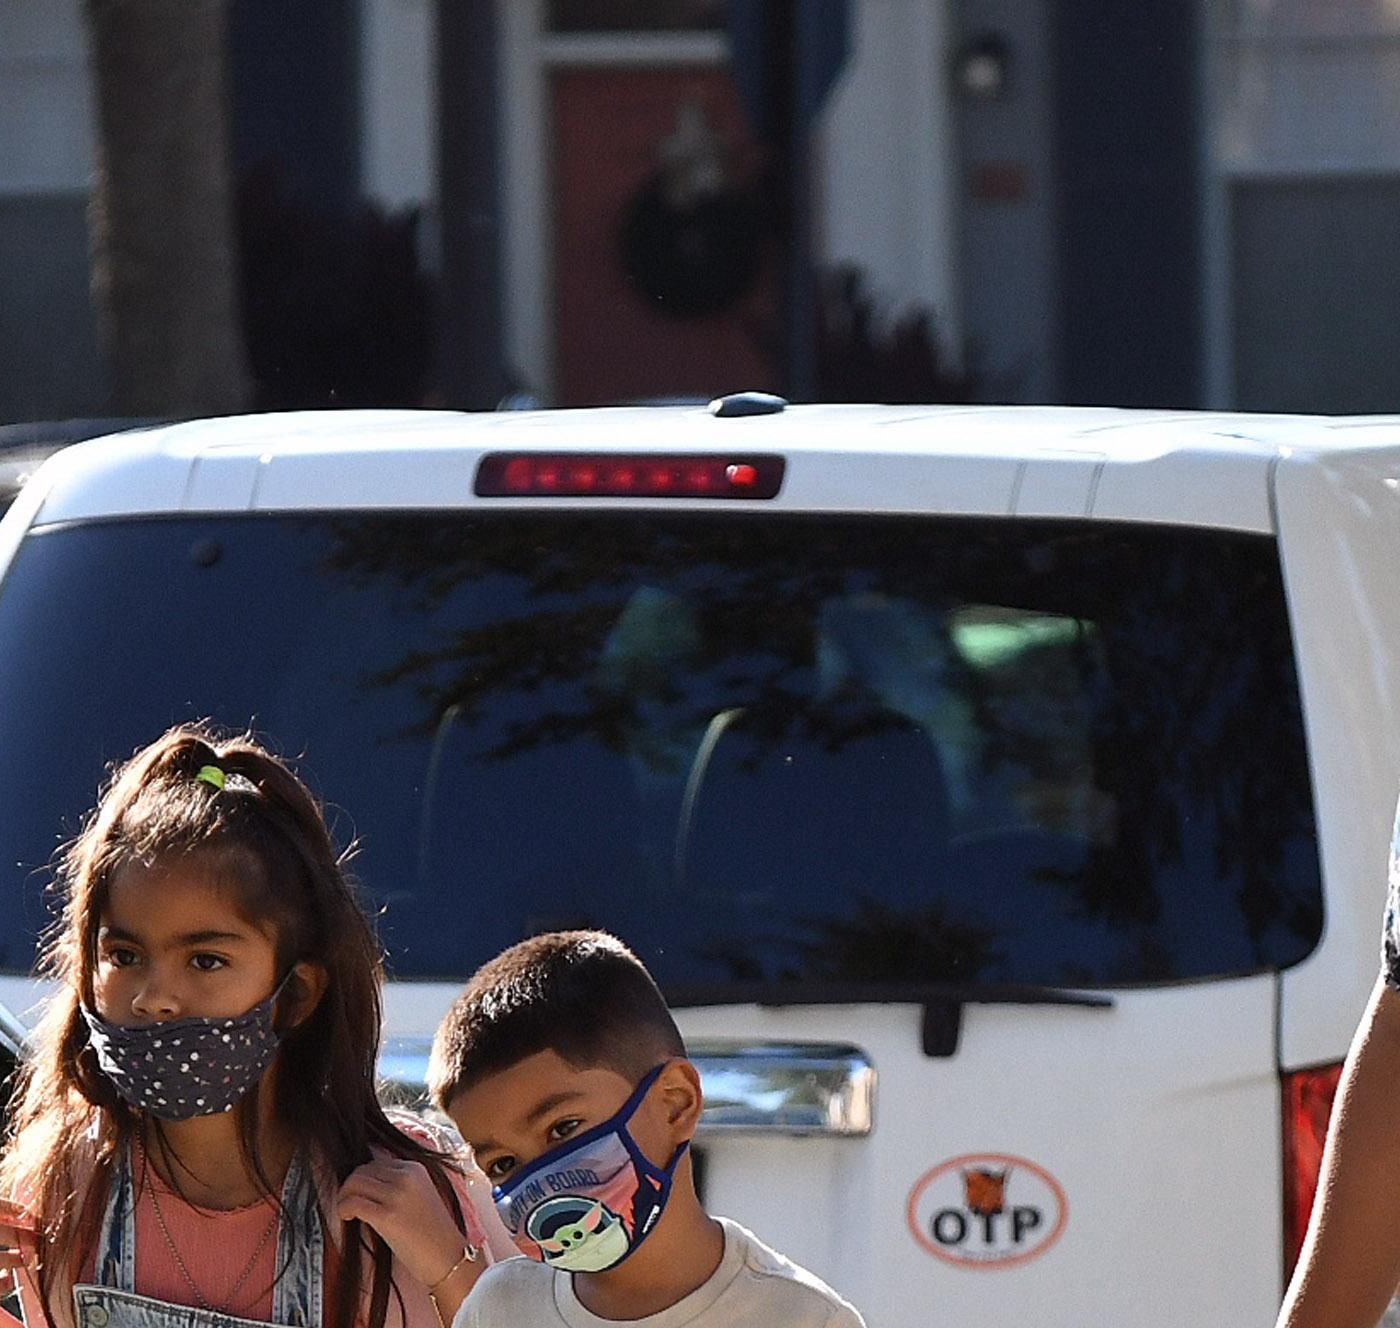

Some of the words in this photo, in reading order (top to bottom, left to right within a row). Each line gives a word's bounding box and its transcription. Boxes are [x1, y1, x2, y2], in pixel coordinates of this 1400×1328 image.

[525, 1180, 546, 1203] ON
[545, 1168, 600, 1192] BOARD
[933, 1206, 1040, 1244] OTP
